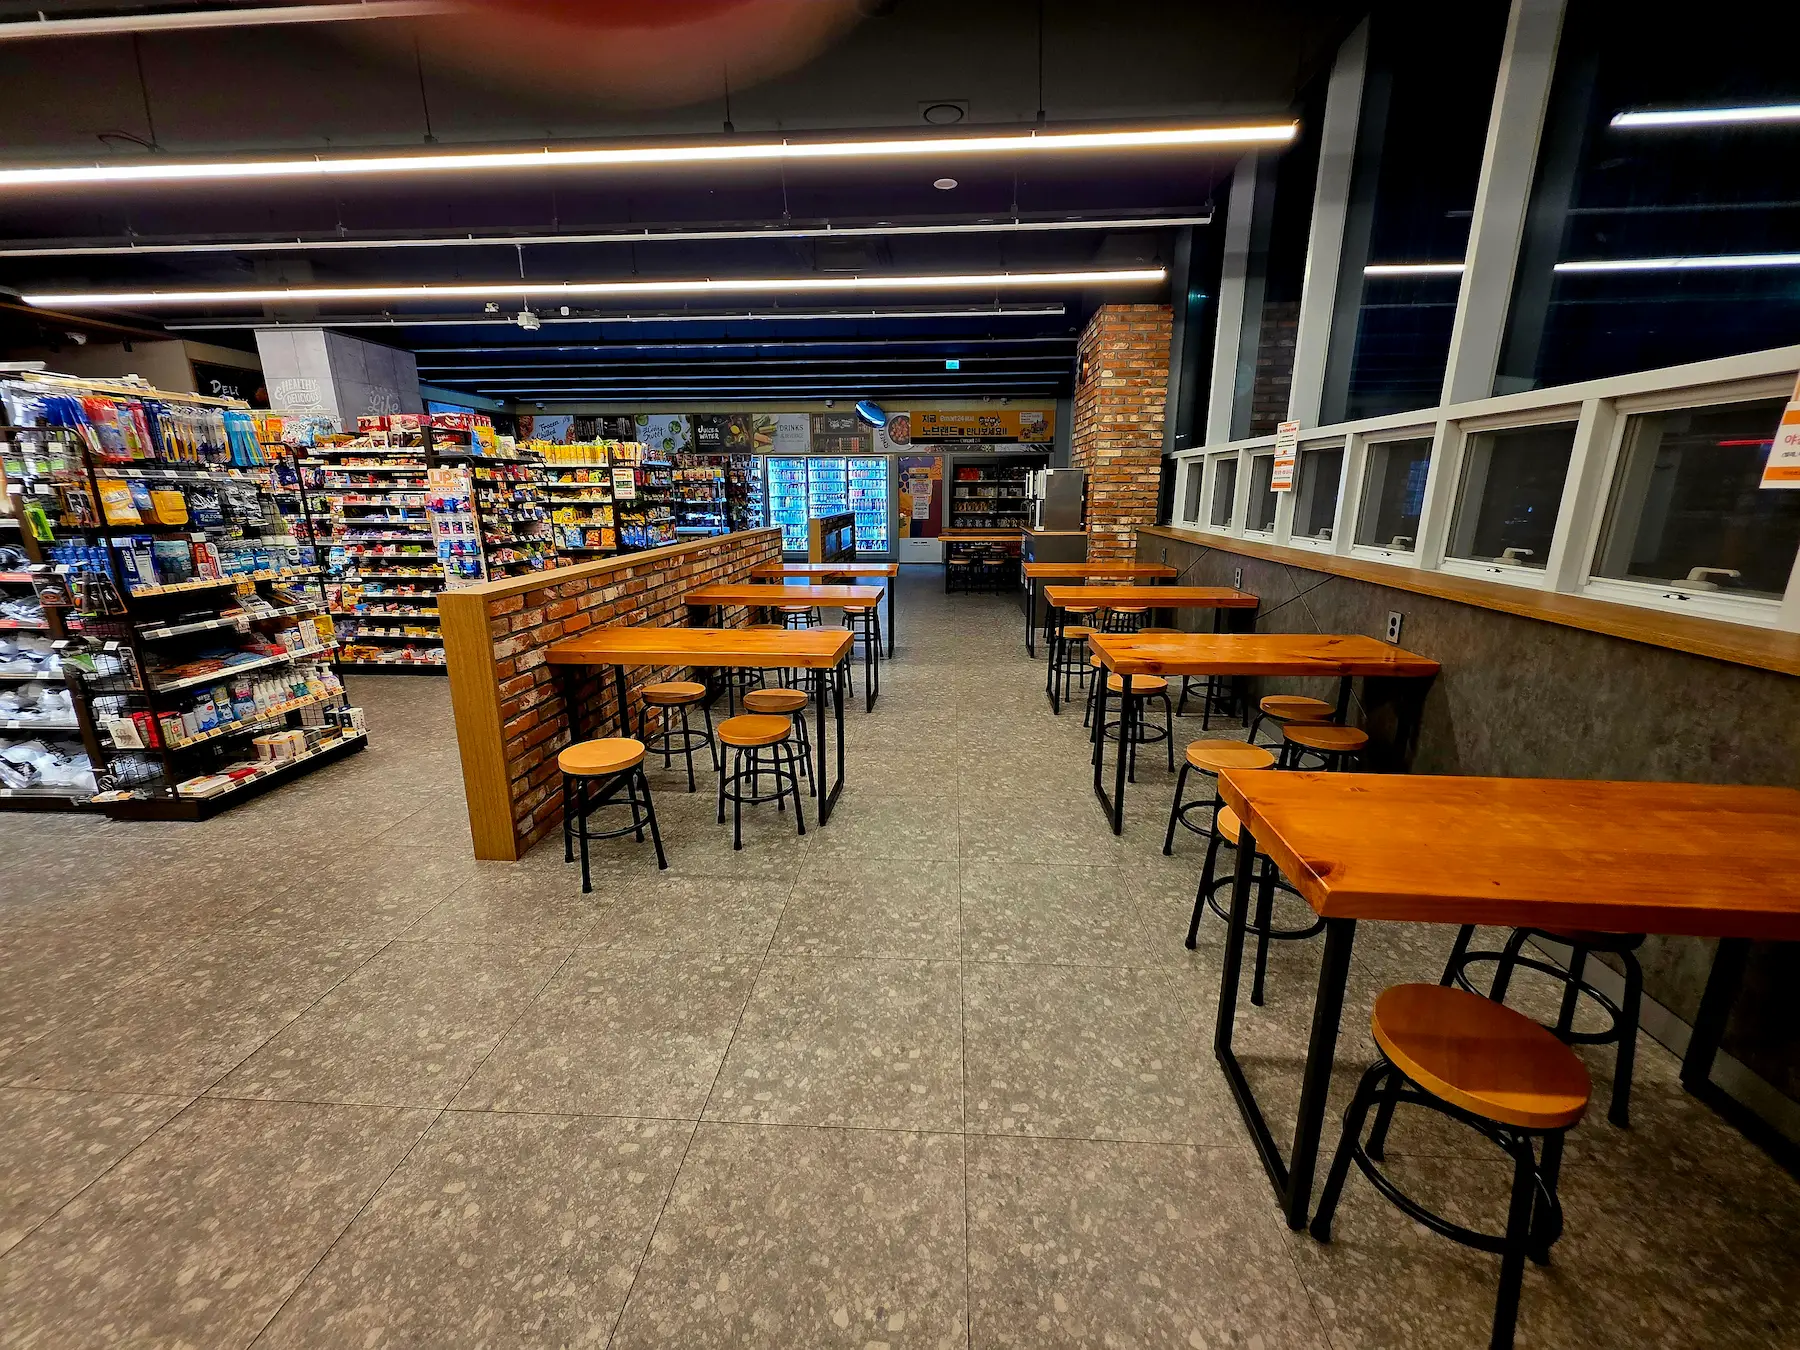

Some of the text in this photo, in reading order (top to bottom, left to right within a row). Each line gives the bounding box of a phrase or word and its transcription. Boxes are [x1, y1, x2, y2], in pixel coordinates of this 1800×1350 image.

[281, 378, 317, 391] HEALTHY
[286, 391, 320, 405] DELICIOUS
[368, 394, 399, 415] Life
[922, 414, 937, 423] 지금
[779, 424, 804, 432] DRINKS
